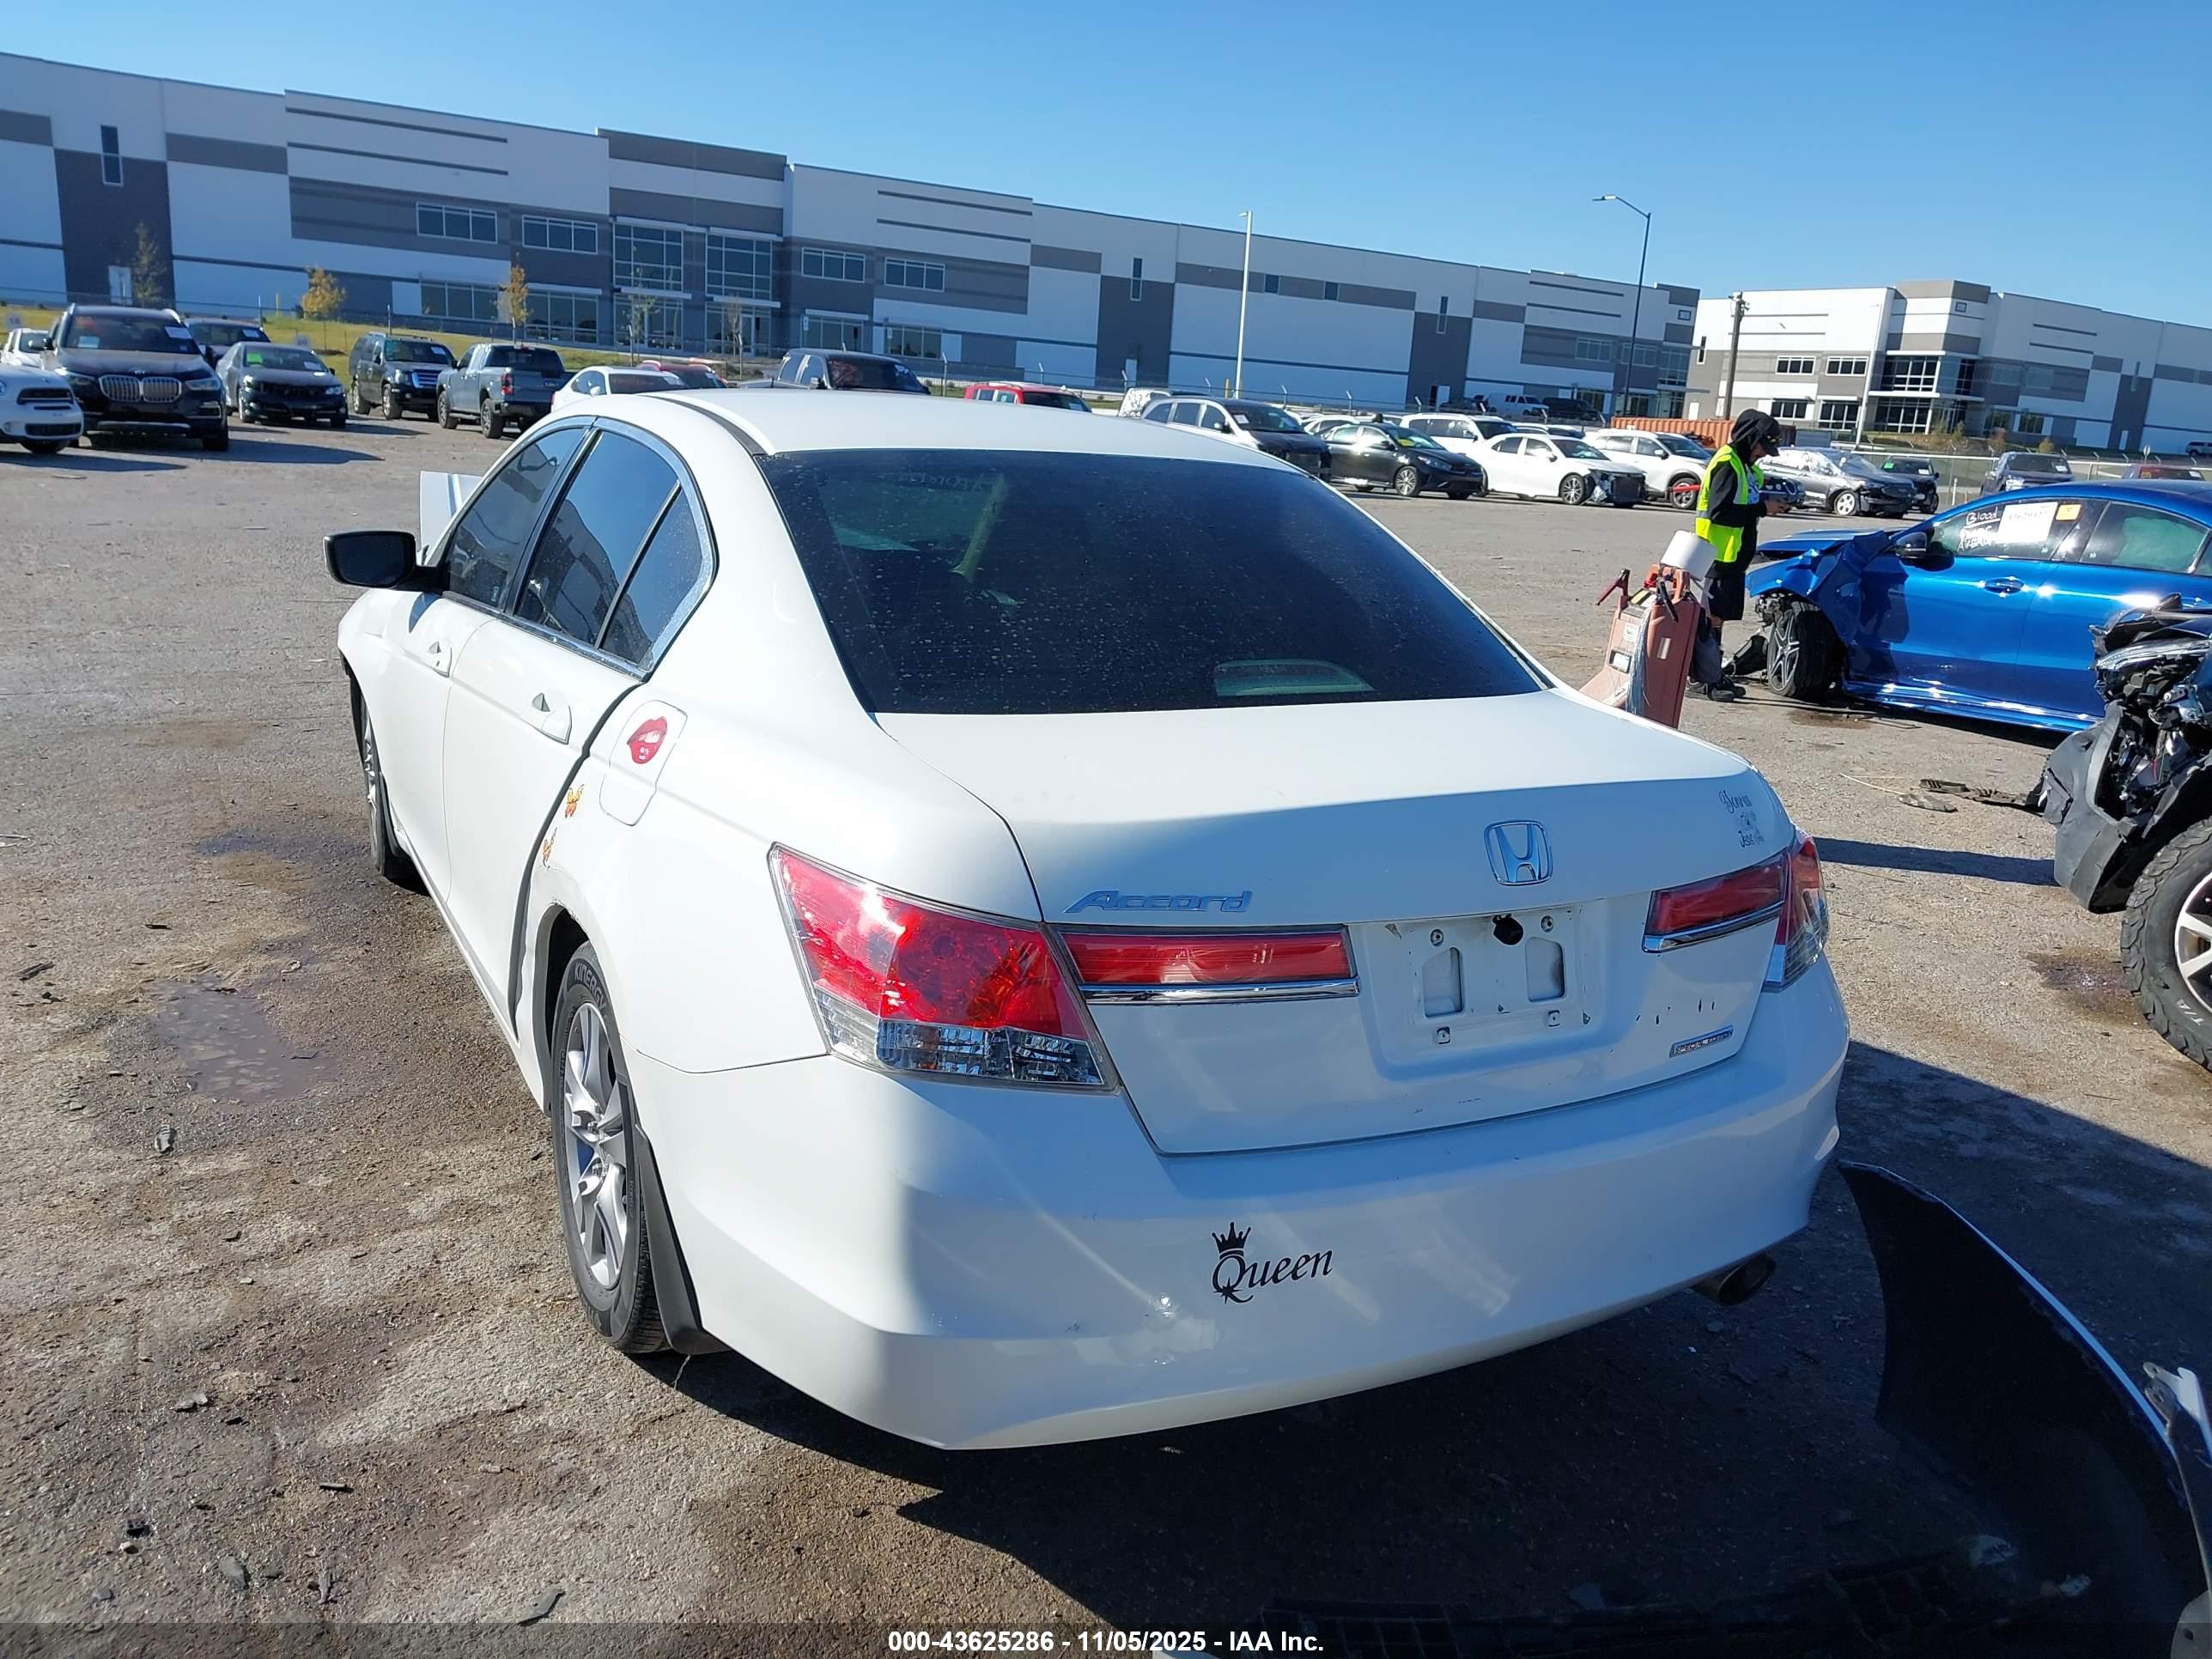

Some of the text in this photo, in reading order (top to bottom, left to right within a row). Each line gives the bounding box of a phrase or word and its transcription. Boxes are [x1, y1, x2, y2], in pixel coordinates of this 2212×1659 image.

[1966, 507, 1998, 526] Blood
[1063, 890, 1252, 913] Accord
[1212, 1249, 1334, 1304] Queen
